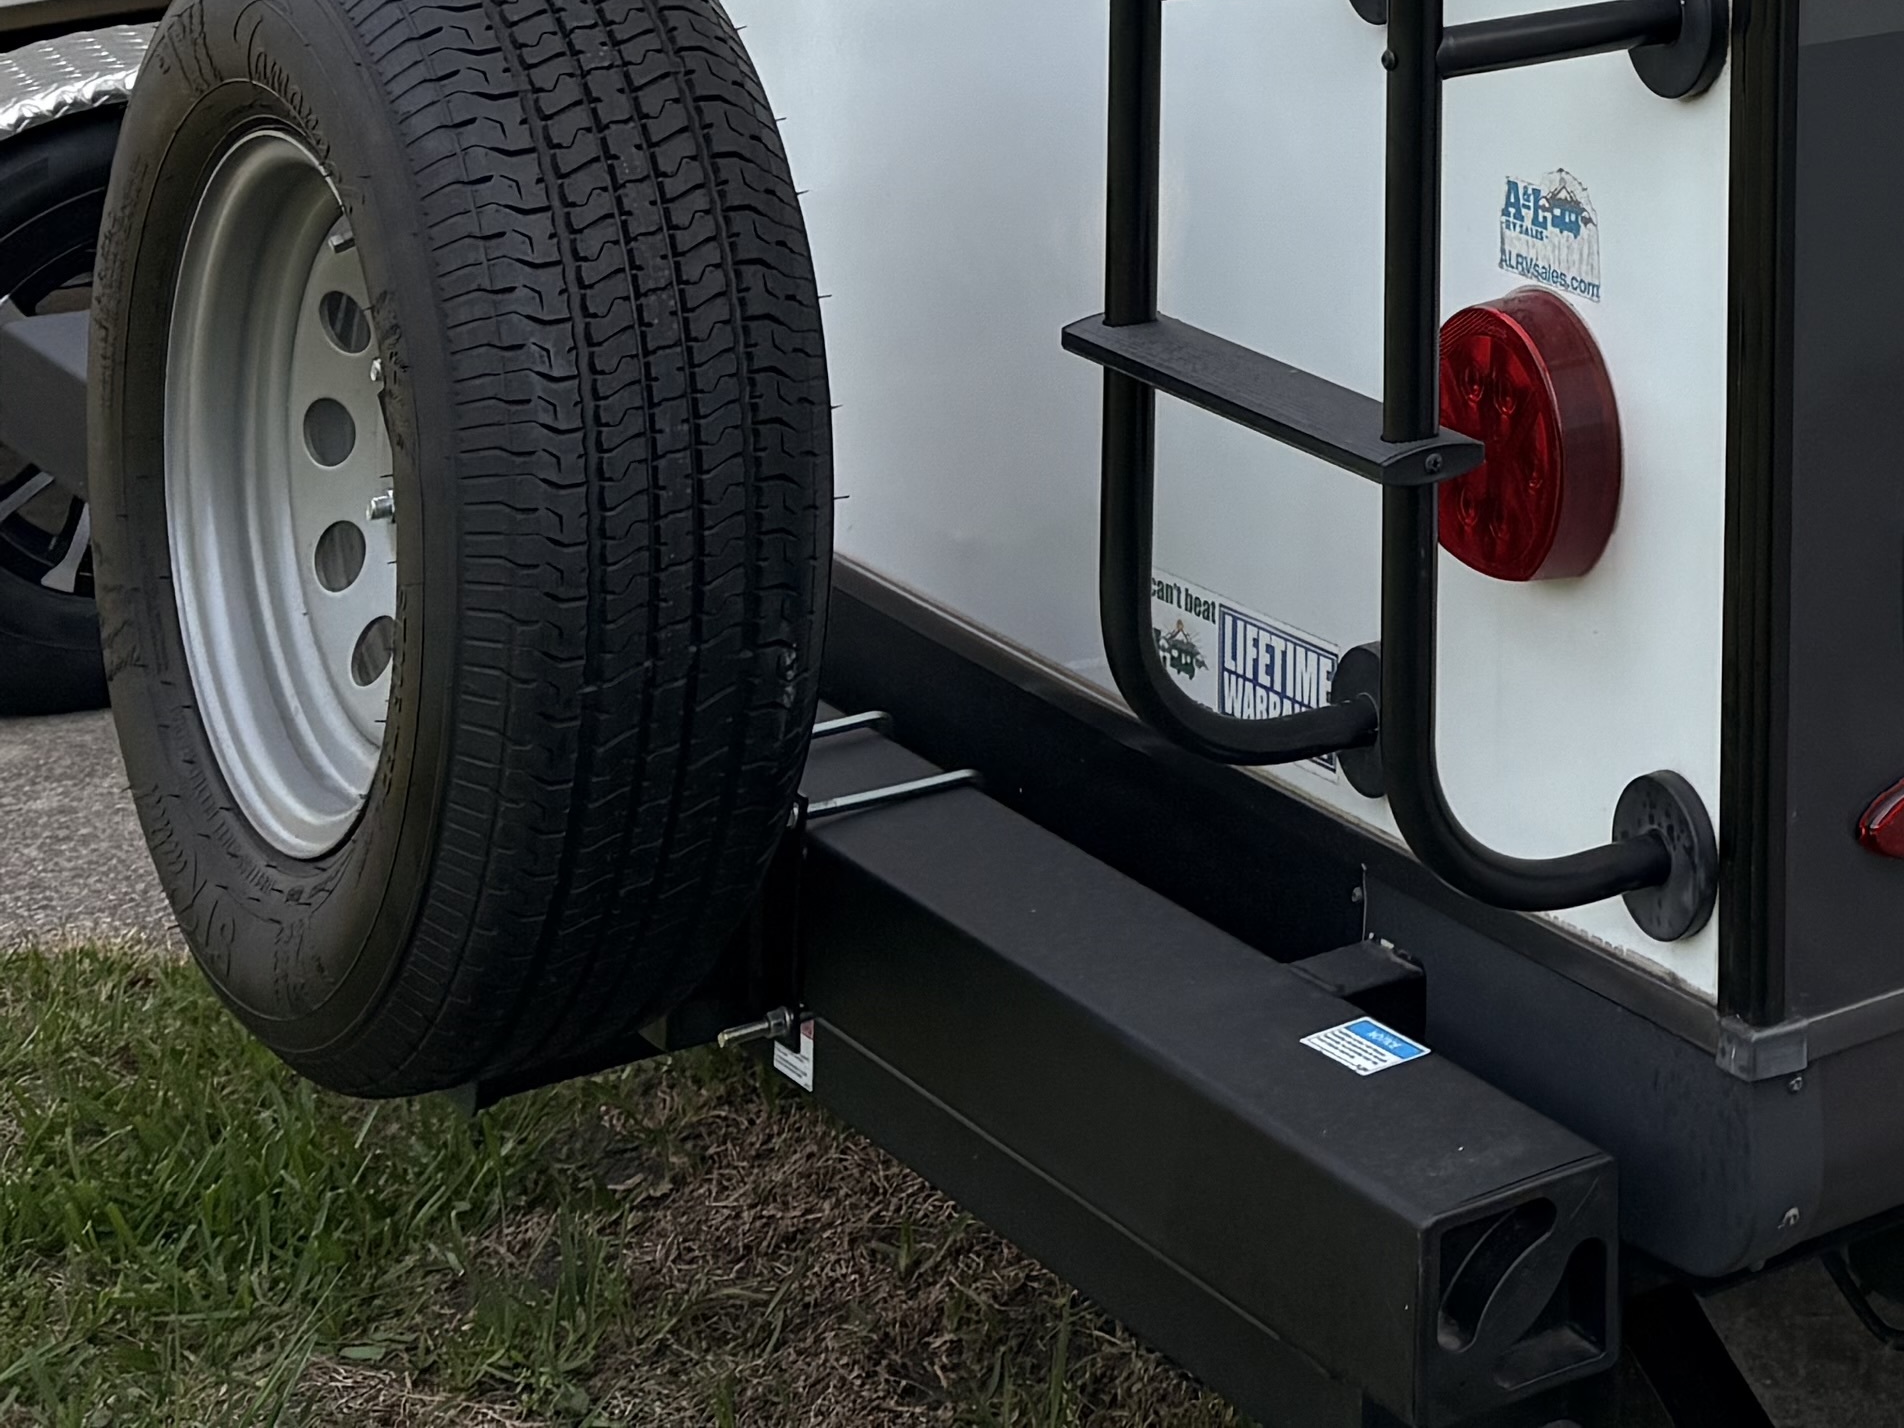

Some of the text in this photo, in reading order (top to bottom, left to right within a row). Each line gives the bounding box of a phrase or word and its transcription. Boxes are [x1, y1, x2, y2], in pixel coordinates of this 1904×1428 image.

[1519, 223, 1544, 242] SALES
[1500, 247, 1600, 299] ALRVsales.com
[1184, 587, 1216, 625] beat
[1223, 613, 1333, 708] LIFETIME
